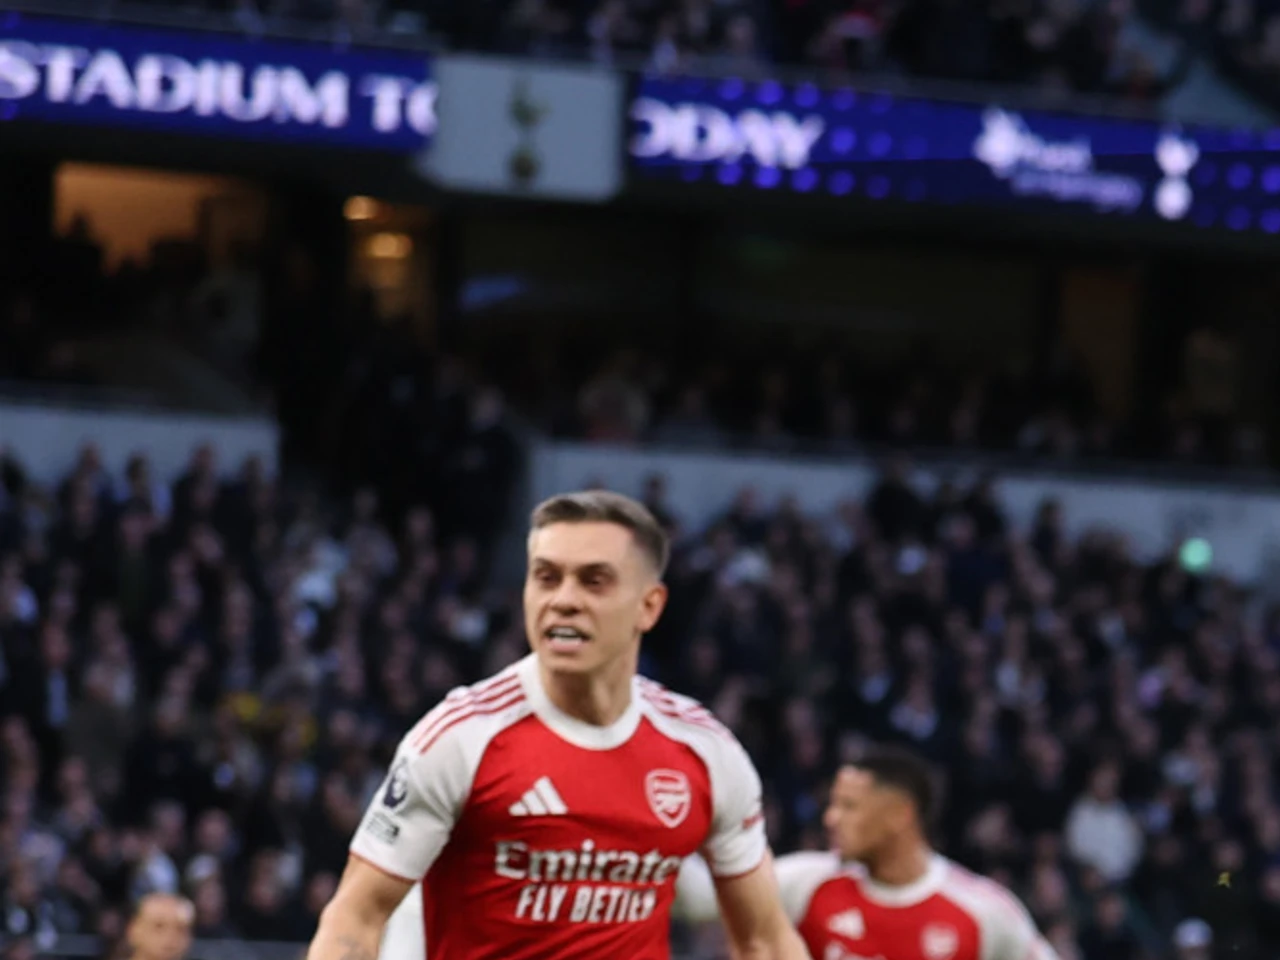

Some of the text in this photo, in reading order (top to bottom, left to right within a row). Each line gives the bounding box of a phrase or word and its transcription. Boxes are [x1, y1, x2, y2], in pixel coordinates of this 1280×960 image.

[0, 40, 349, 132] STADIUM
[495, 838, 681, 885] Emirate
[515, 884, 568, 922] FLY
